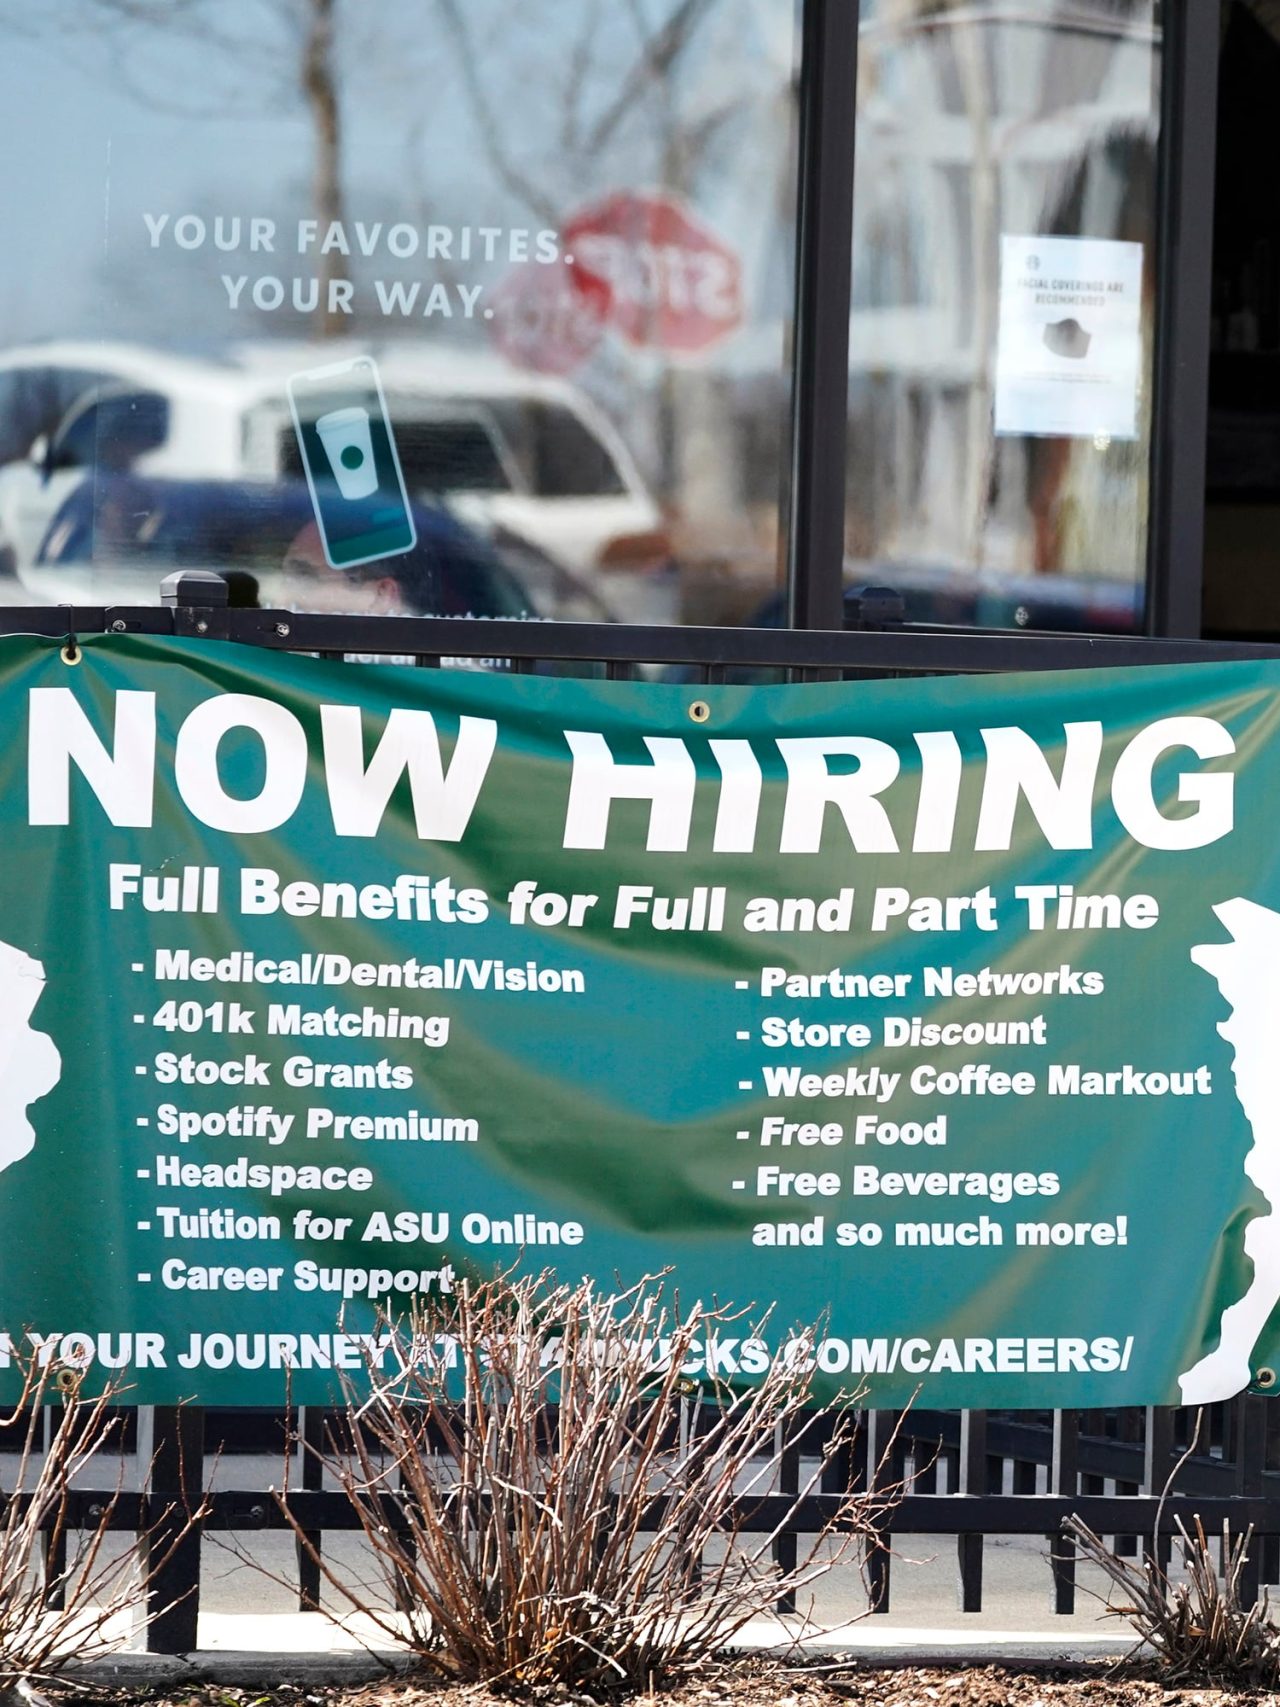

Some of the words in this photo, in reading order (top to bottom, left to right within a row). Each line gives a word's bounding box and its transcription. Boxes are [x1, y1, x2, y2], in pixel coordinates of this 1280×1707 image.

[143, 213, 276, 252] YOUR
[297, 219, 575, 265] FAVORITES.
[221, 275, 354, 314] YOUR
[375, 281, 494, 320] WAY.
[1108, 282, 1124, 293] ARE
[28, 688, 497, 841] NOW
[563, 716, 1236, 854] HIRING
[110, 864, 219, 913] Full
[241, 868, 488, 923] Benefits
[508, 881, 598, 926] for
[614, 886, 726, 931] Full
[744, 888, 855, 932] and
[871, 886, 997, 931] Part
[1015, 885, 1159, 930] Time
[156, 949, 584, 992] Medical/Dental/Vision
[761, 968, 912, 997] Partner
[924, 964, 1104, 997] Networks
[153, 1001, 255, 1033] 401k
[268, 1004, 450, 1047] Matching
[762, 1017, 871, 1047] Store
[884, 1015, 1046, 1047] Discount
[155, 1053, 270, 1085] Stock
[283, 1056, 413, 1089] Grants
[763, 1067, 901, 1103] Weekly
[910, 1064, 1035, 1095] Coffee
[1048, 1065, 1211, 1095] Markout
[158, 1104, 295, 1145] Spotify
[307, 1108, 478, 1141] Premium
[760, 1117, 843, 1146] Free
[855, 1115, 946, 1145] Food
[157, 1156, 372, 1195] Headspace
[757, 1166, 841, 1196] Free
[854, 1166, 1060, 1203] Beverages
[157, 1207, 280, 1239] Tuition
[293, 1210, 352, 1239] for
[362, 1212, 448, 1243] ASU
[462, 1213, 583, 1245] Online
[752, 1216, 824, 1246] and
[836, 1223, 882, 1246] so
[896, 1216, 1002, 1245] much
[1016, 1216, 1127, 1245] more!
[162, 1259, 283, 1290] Career
[295, 1261, 455, 1298] Support
[25, 1332, 168, 1369] YOUR
[178, 1333, 394, 1370] JOURNEY
